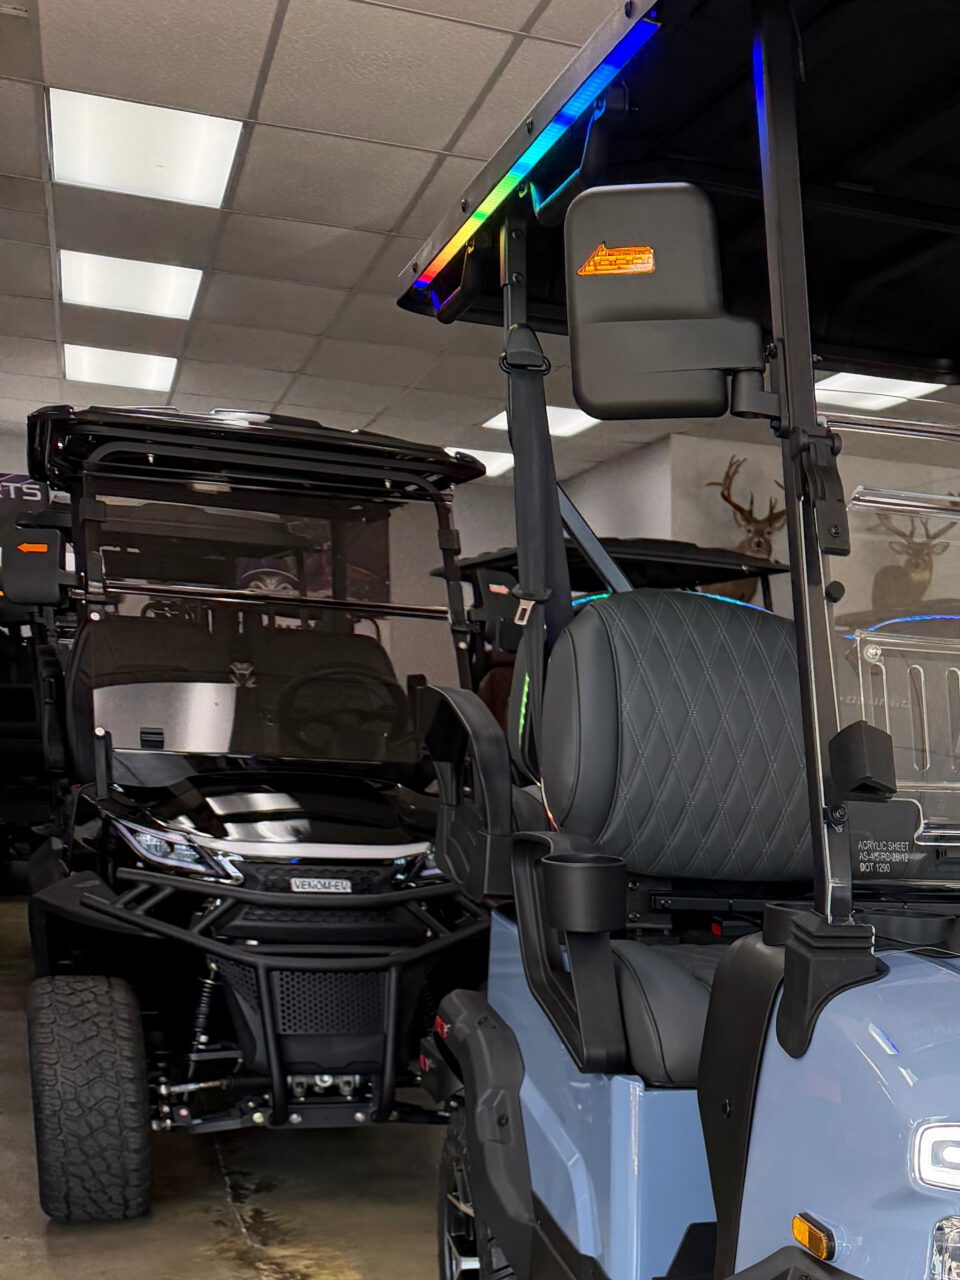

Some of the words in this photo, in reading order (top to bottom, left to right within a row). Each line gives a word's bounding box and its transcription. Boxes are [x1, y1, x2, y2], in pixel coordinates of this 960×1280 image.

[0, 482, 42, 501] TS
[858, 840, 887, 851] ACRYLIC
[887, 841, 909, 852] SHEET
[859, 862, 874, 873] DOT
[876, 863, 891, 873] 1290
[294, 880, 348, 891] VENOM-EV
